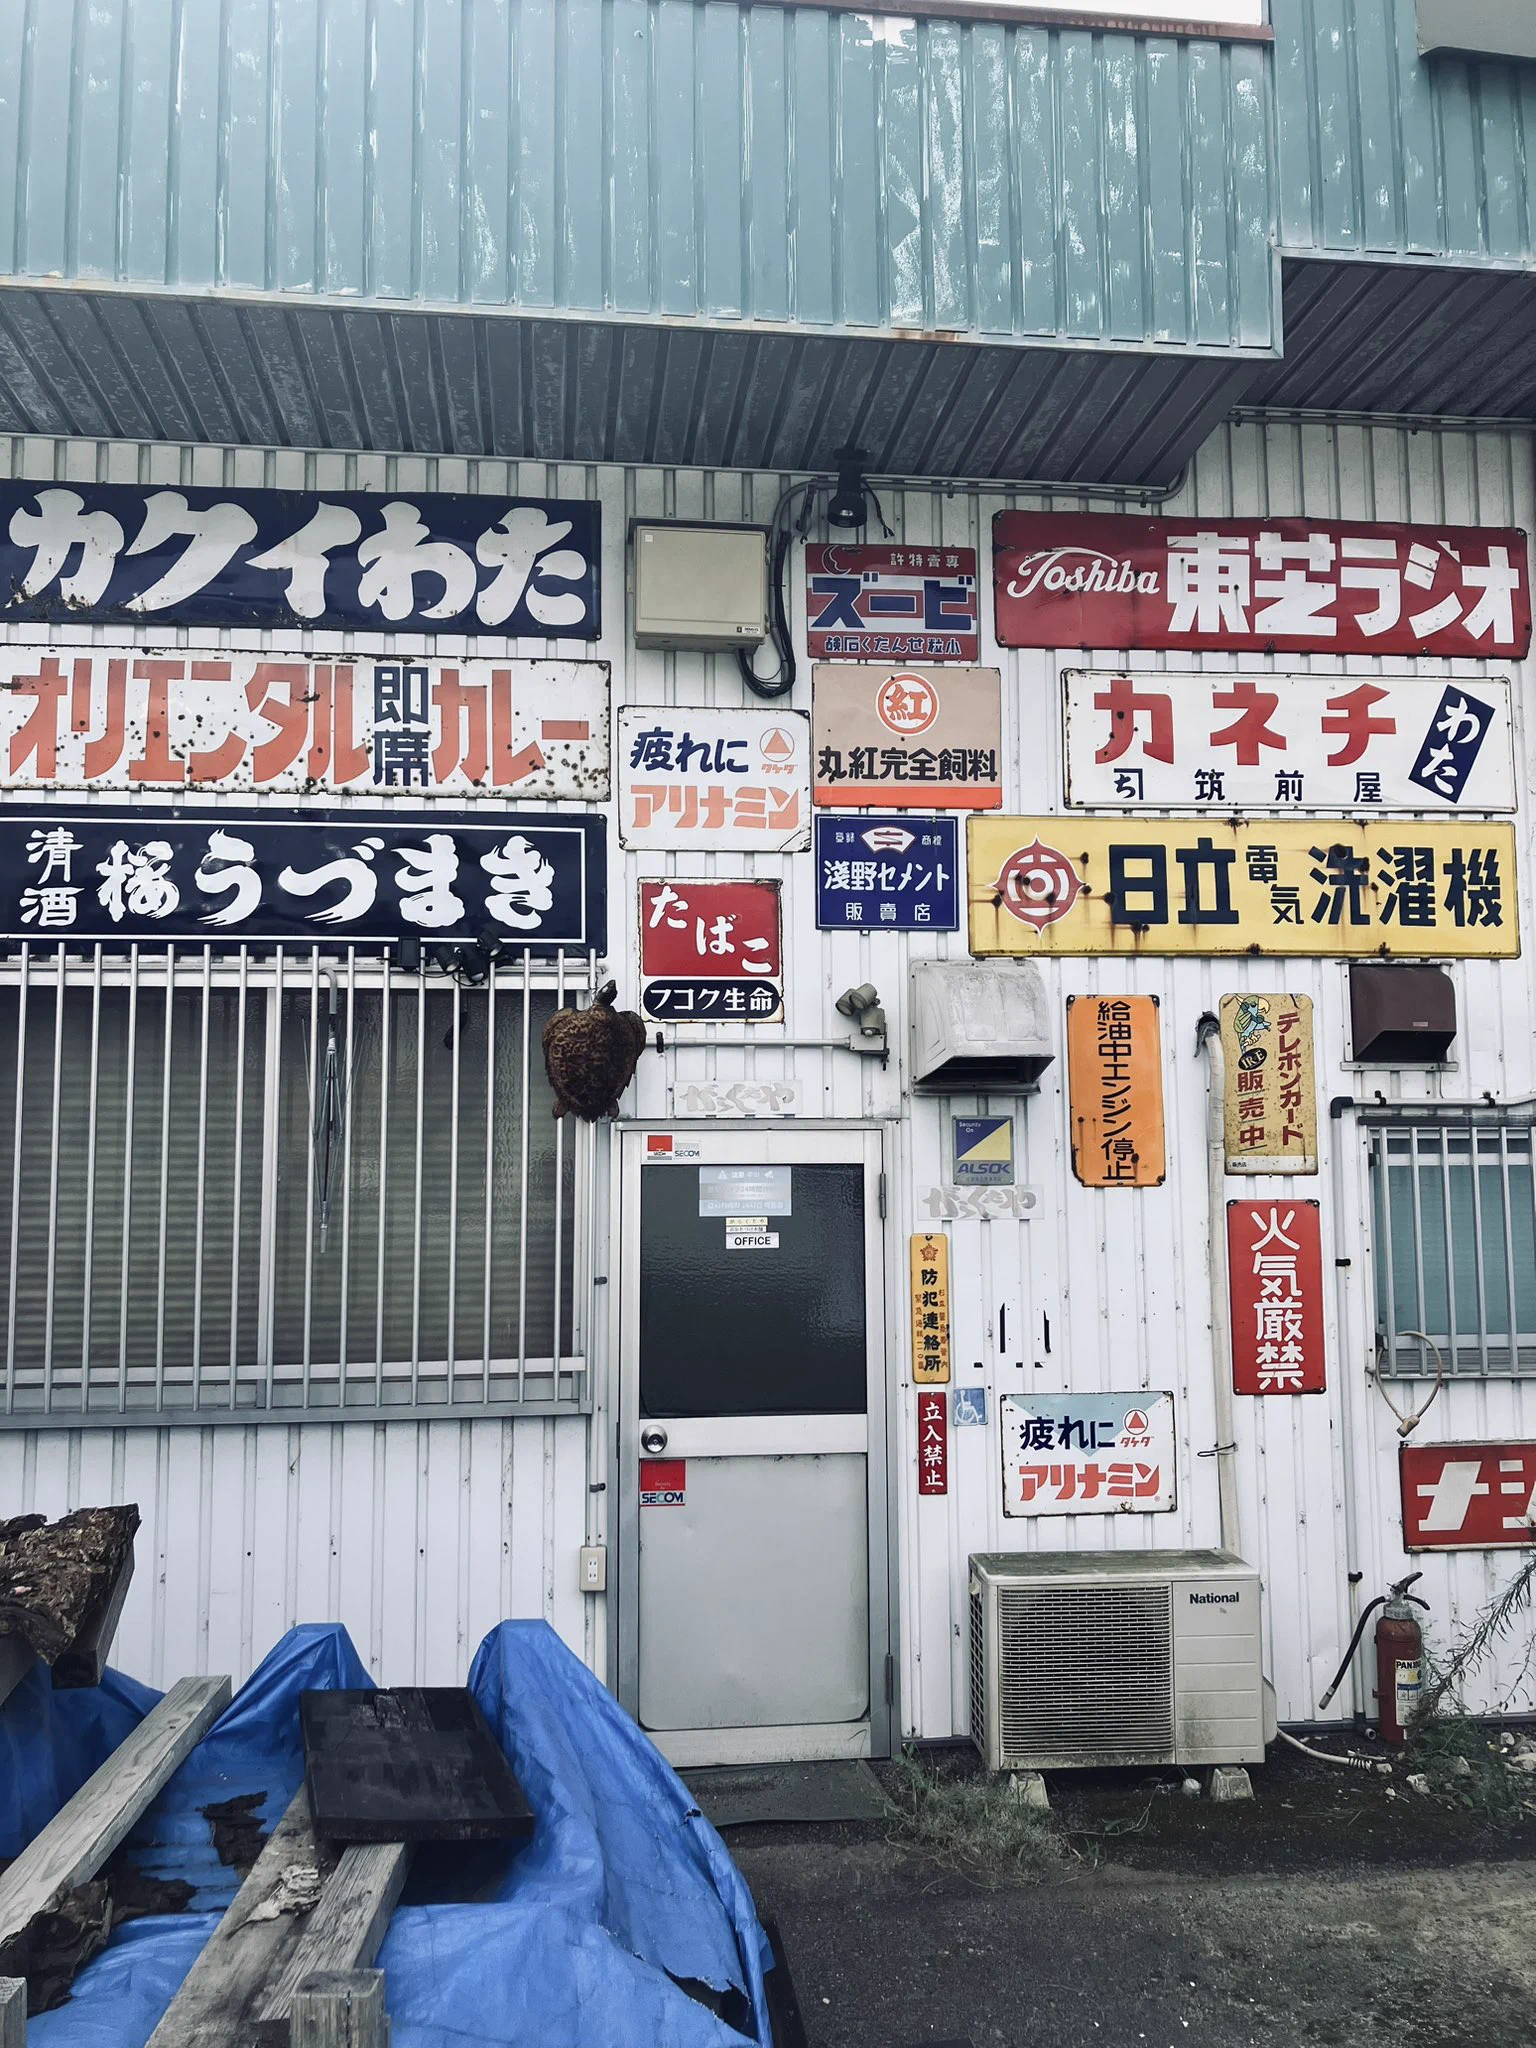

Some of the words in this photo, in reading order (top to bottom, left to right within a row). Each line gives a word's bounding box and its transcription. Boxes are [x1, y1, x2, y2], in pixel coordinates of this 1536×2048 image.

[9, 489, 587, 626] カクイわた
[1007, 546, 1160, 600] Toshiba
[1166, 532, 1520, 644] 東芝ラジオ
[1093, 679, 1397, 767] カネチ
[1420, 696, 1481, 794] わた
[630, 726, 749, 773] 疲れに
[817, 746, 998, 783] 丸紅完全飼料
[631, 784, 799, 830] アリナミン
[649, 885, 773, 974] たばこ
[650, 986, 774, 1011] フコク生命
[1097, 1000, 1136, 1181] 給油中エンジン停止
[1277, 1011, 1304, 1146] テレホンカード
[1237, 1069, 1265, 1147] 販売中
[675, 1150, 700, 1158] SECOM
[956, 1163, 1011, 1174] ALSOK
[734, 1236, 771, 1246] OFFICE
[921, 1268, 942, 1373] 防犯連絡所
[1251, 1207, 1305, 1390] 火気厳禁
[922, 1401, 944, 1487] 立入禁止
[1019, 1415, 1116, 1451] 疲れに
[1120, 1436, 1151, 1448] タケダ
[642, 1492, 684, 1503] SECOM
[1019, 1463, 1160, 1502] アリナミン
[1189, 1592, 1240, 1604] National
